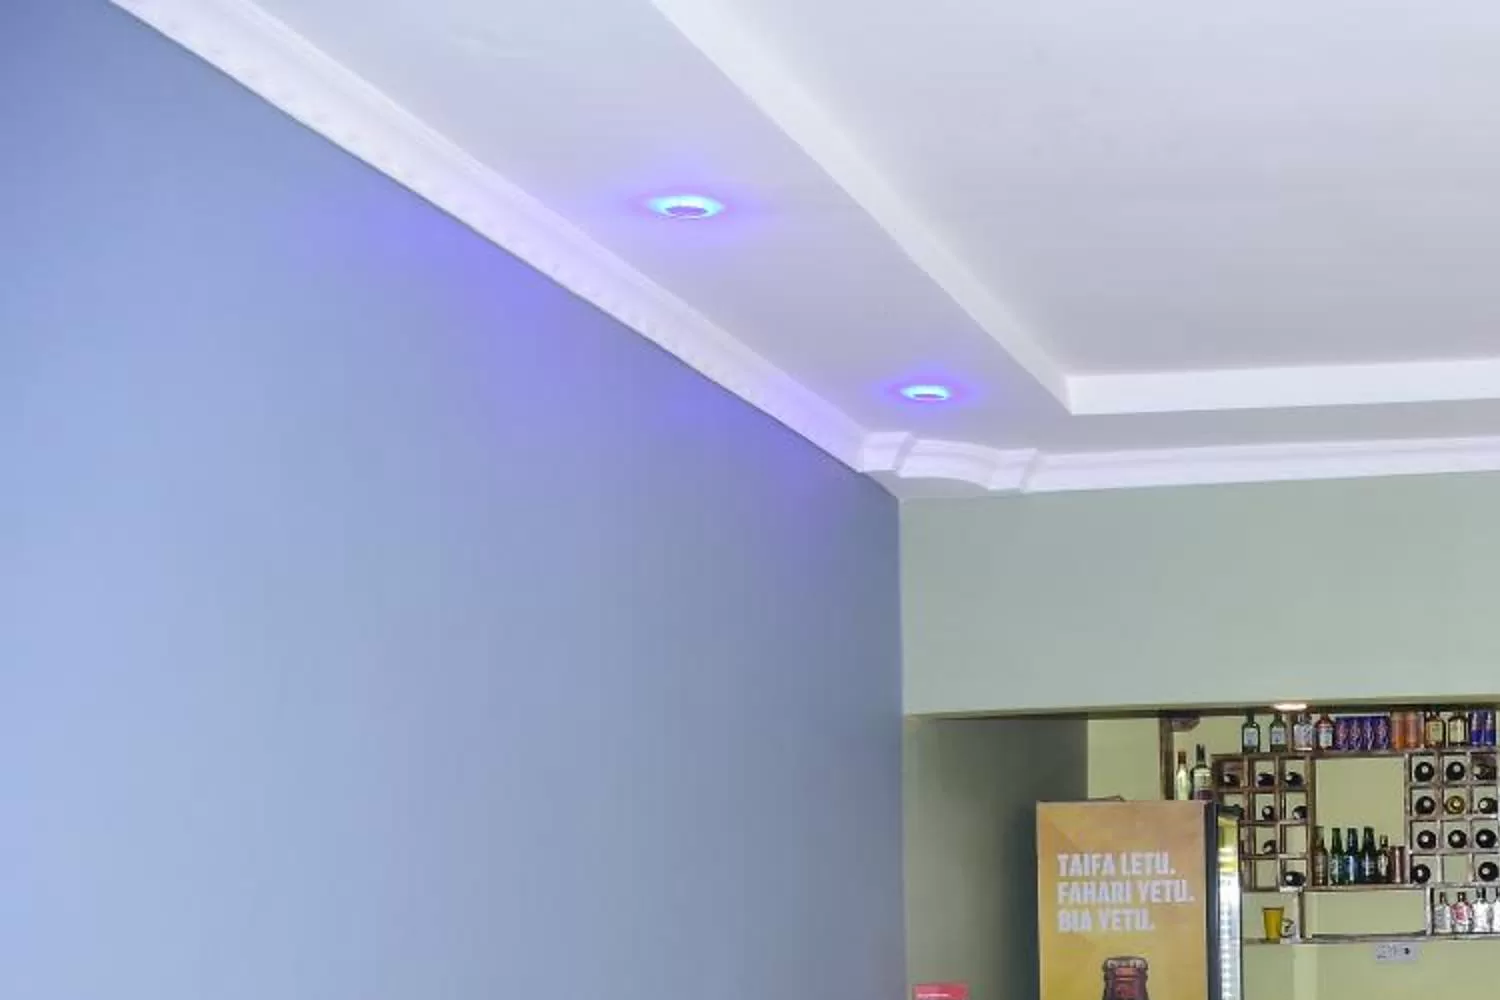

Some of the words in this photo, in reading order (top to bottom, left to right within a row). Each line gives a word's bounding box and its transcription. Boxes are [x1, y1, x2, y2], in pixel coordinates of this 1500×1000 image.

[1057, 852, 1116, 876] TAIFA
[1121, 851, 1176, 875] LETU.
[1057, 880, 1132, 904] FAHARI
[1138, 879, 1196, 902] YETU.
[1058, 908, 1092, 932] BIA
[1098, 907, 1156, 931] YETU.
